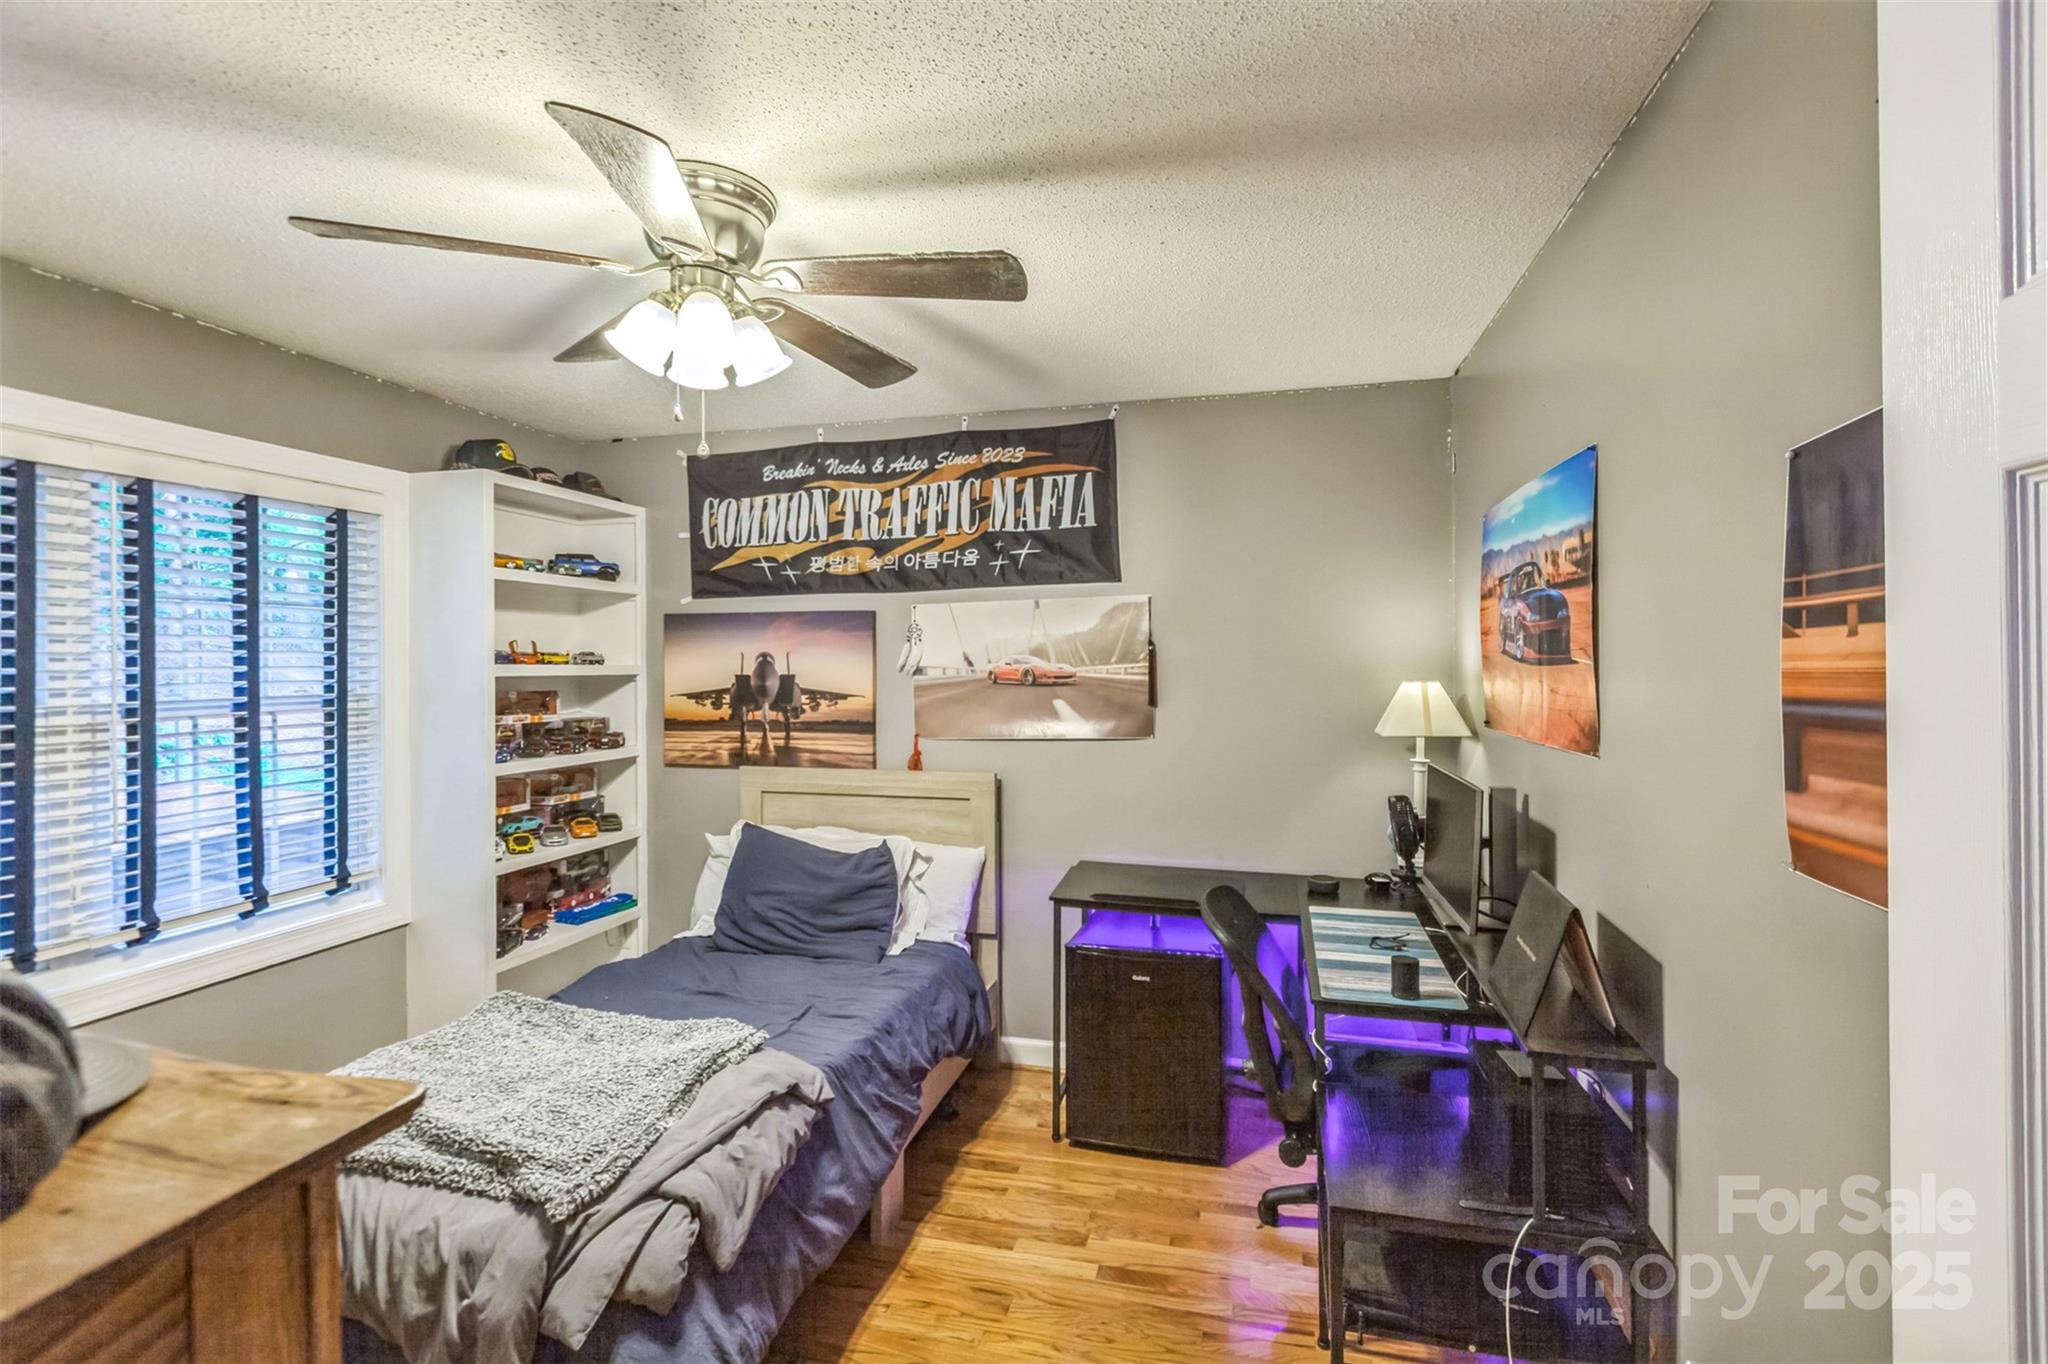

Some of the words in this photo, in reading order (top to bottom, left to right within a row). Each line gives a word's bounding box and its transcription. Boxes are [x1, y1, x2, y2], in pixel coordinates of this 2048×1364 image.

[762, 458, 821, 482] Breakin'
[825, 458, 866, 476] Necks
[872, 456, 885, 473] &
[935, 451, 977, 469] Since
[982, 447, 1026, 463] 2023
[702, 488, 831, 550] COMMON
[838, 477, 982, 541] TRAFFIC
[987, 472, 1097, 532] MAFIA
[865, 554, 899, 572] 속의
[904, 548, 981, 570] 아름다움
